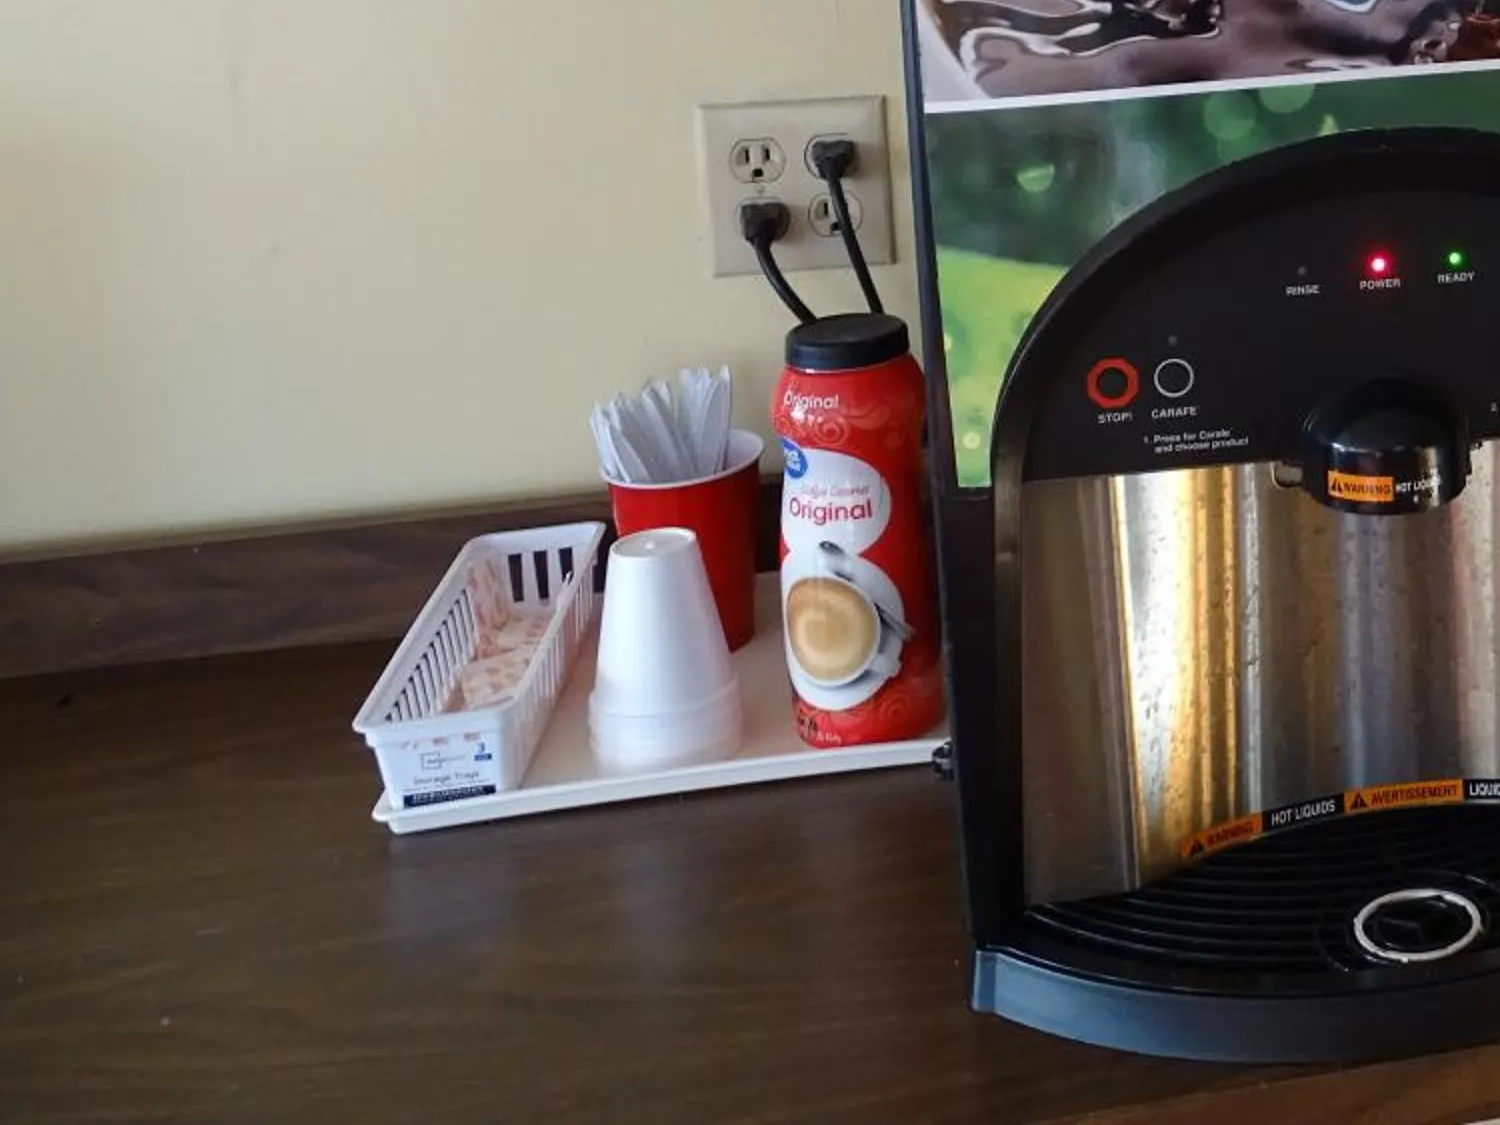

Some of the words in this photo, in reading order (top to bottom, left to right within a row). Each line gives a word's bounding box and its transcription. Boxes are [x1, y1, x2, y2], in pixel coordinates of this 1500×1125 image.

[1359, 278, 1401, 290] POWER
[1437, 272, 1476, 284] READY
[1286, 284, 1320, 296] RINSE
[783, 389, 839, 410] Original
[1151, 406, 1198, 420] CARAFE
[789, 496, 873, 526] Original
[1271, 809, 1292, 826] HOT
[1295, 799, 1336, 820] LIQUIDS
[1371, 784, 1458, 805] AVERTISSEMENT
